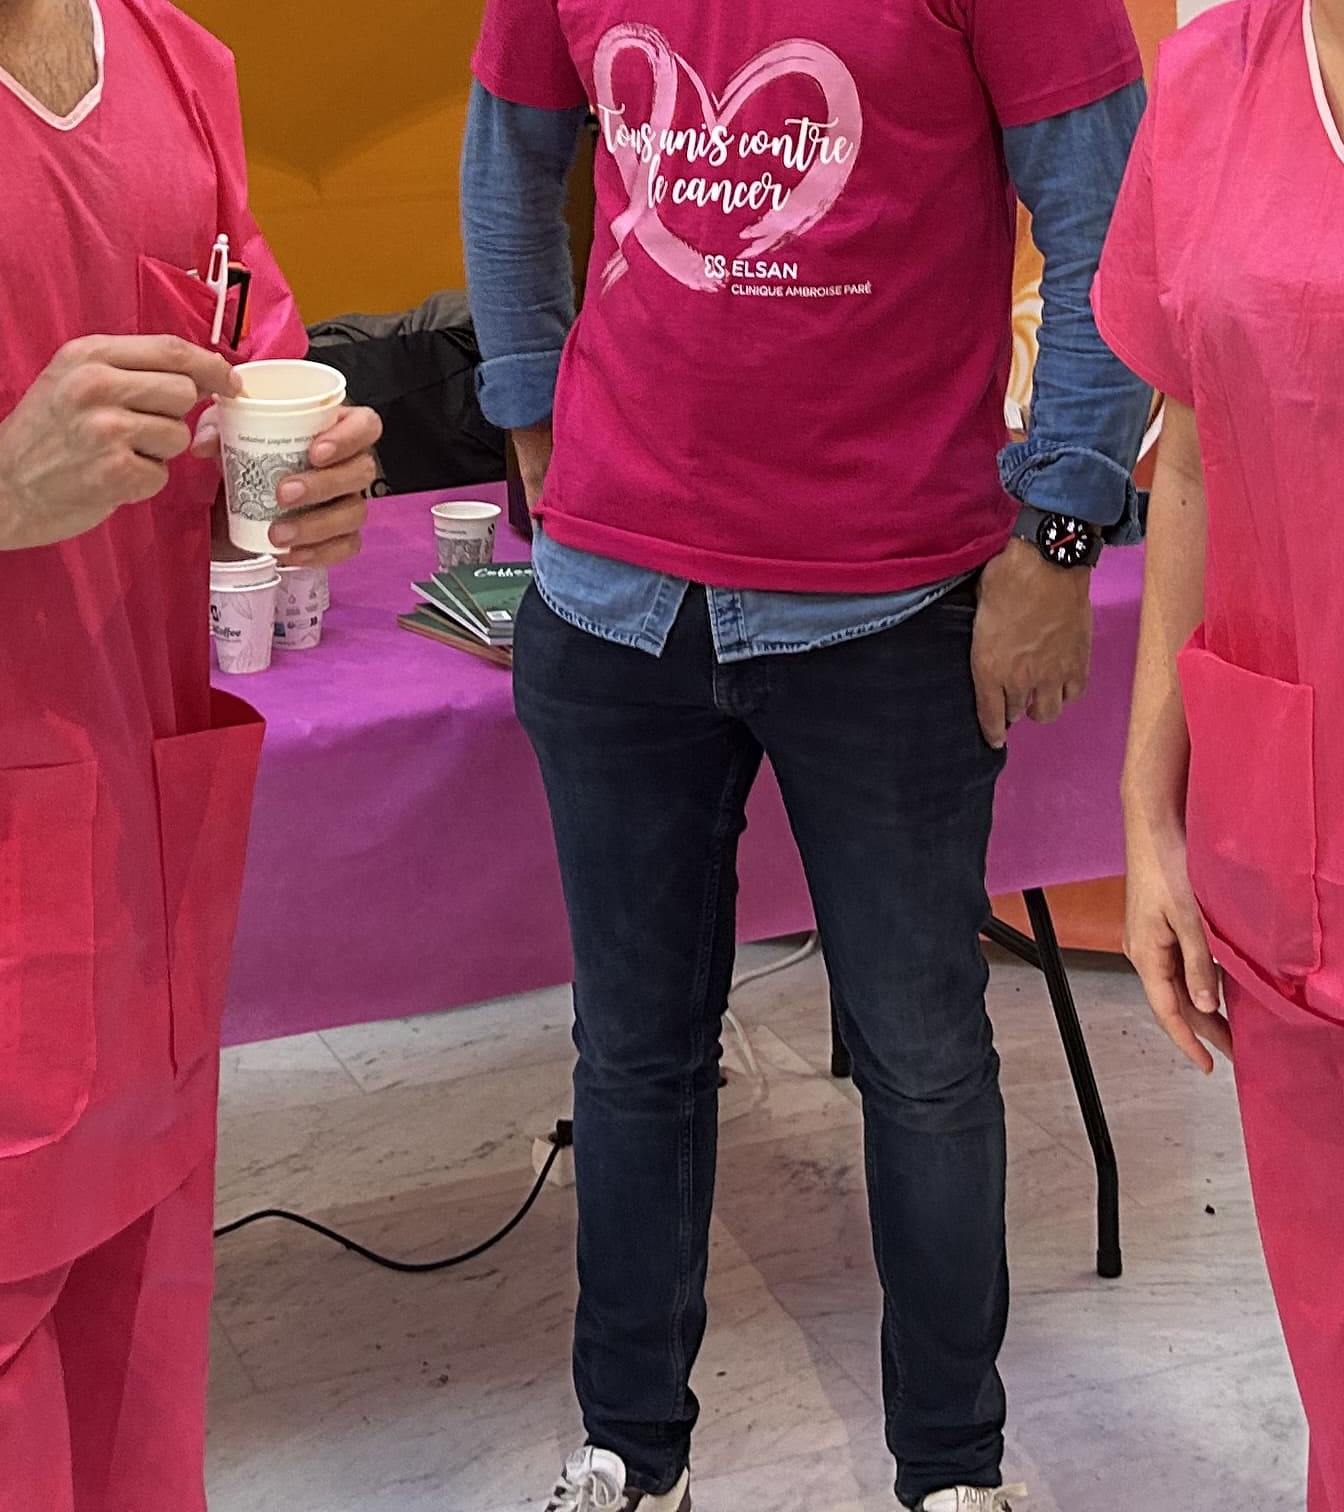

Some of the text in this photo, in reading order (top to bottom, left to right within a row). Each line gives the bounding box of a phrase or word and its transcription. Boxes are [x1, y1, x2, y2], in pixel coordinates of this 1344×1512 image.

[597, 102, 854, 173] Tous unis contre
[647, 152, 792, 215] le cancer
[731, 259, 799, 280] ELSAN
[731, 283, 784, 298] CLINIQUE
[785, 284, 843, 298] AMBROISE
